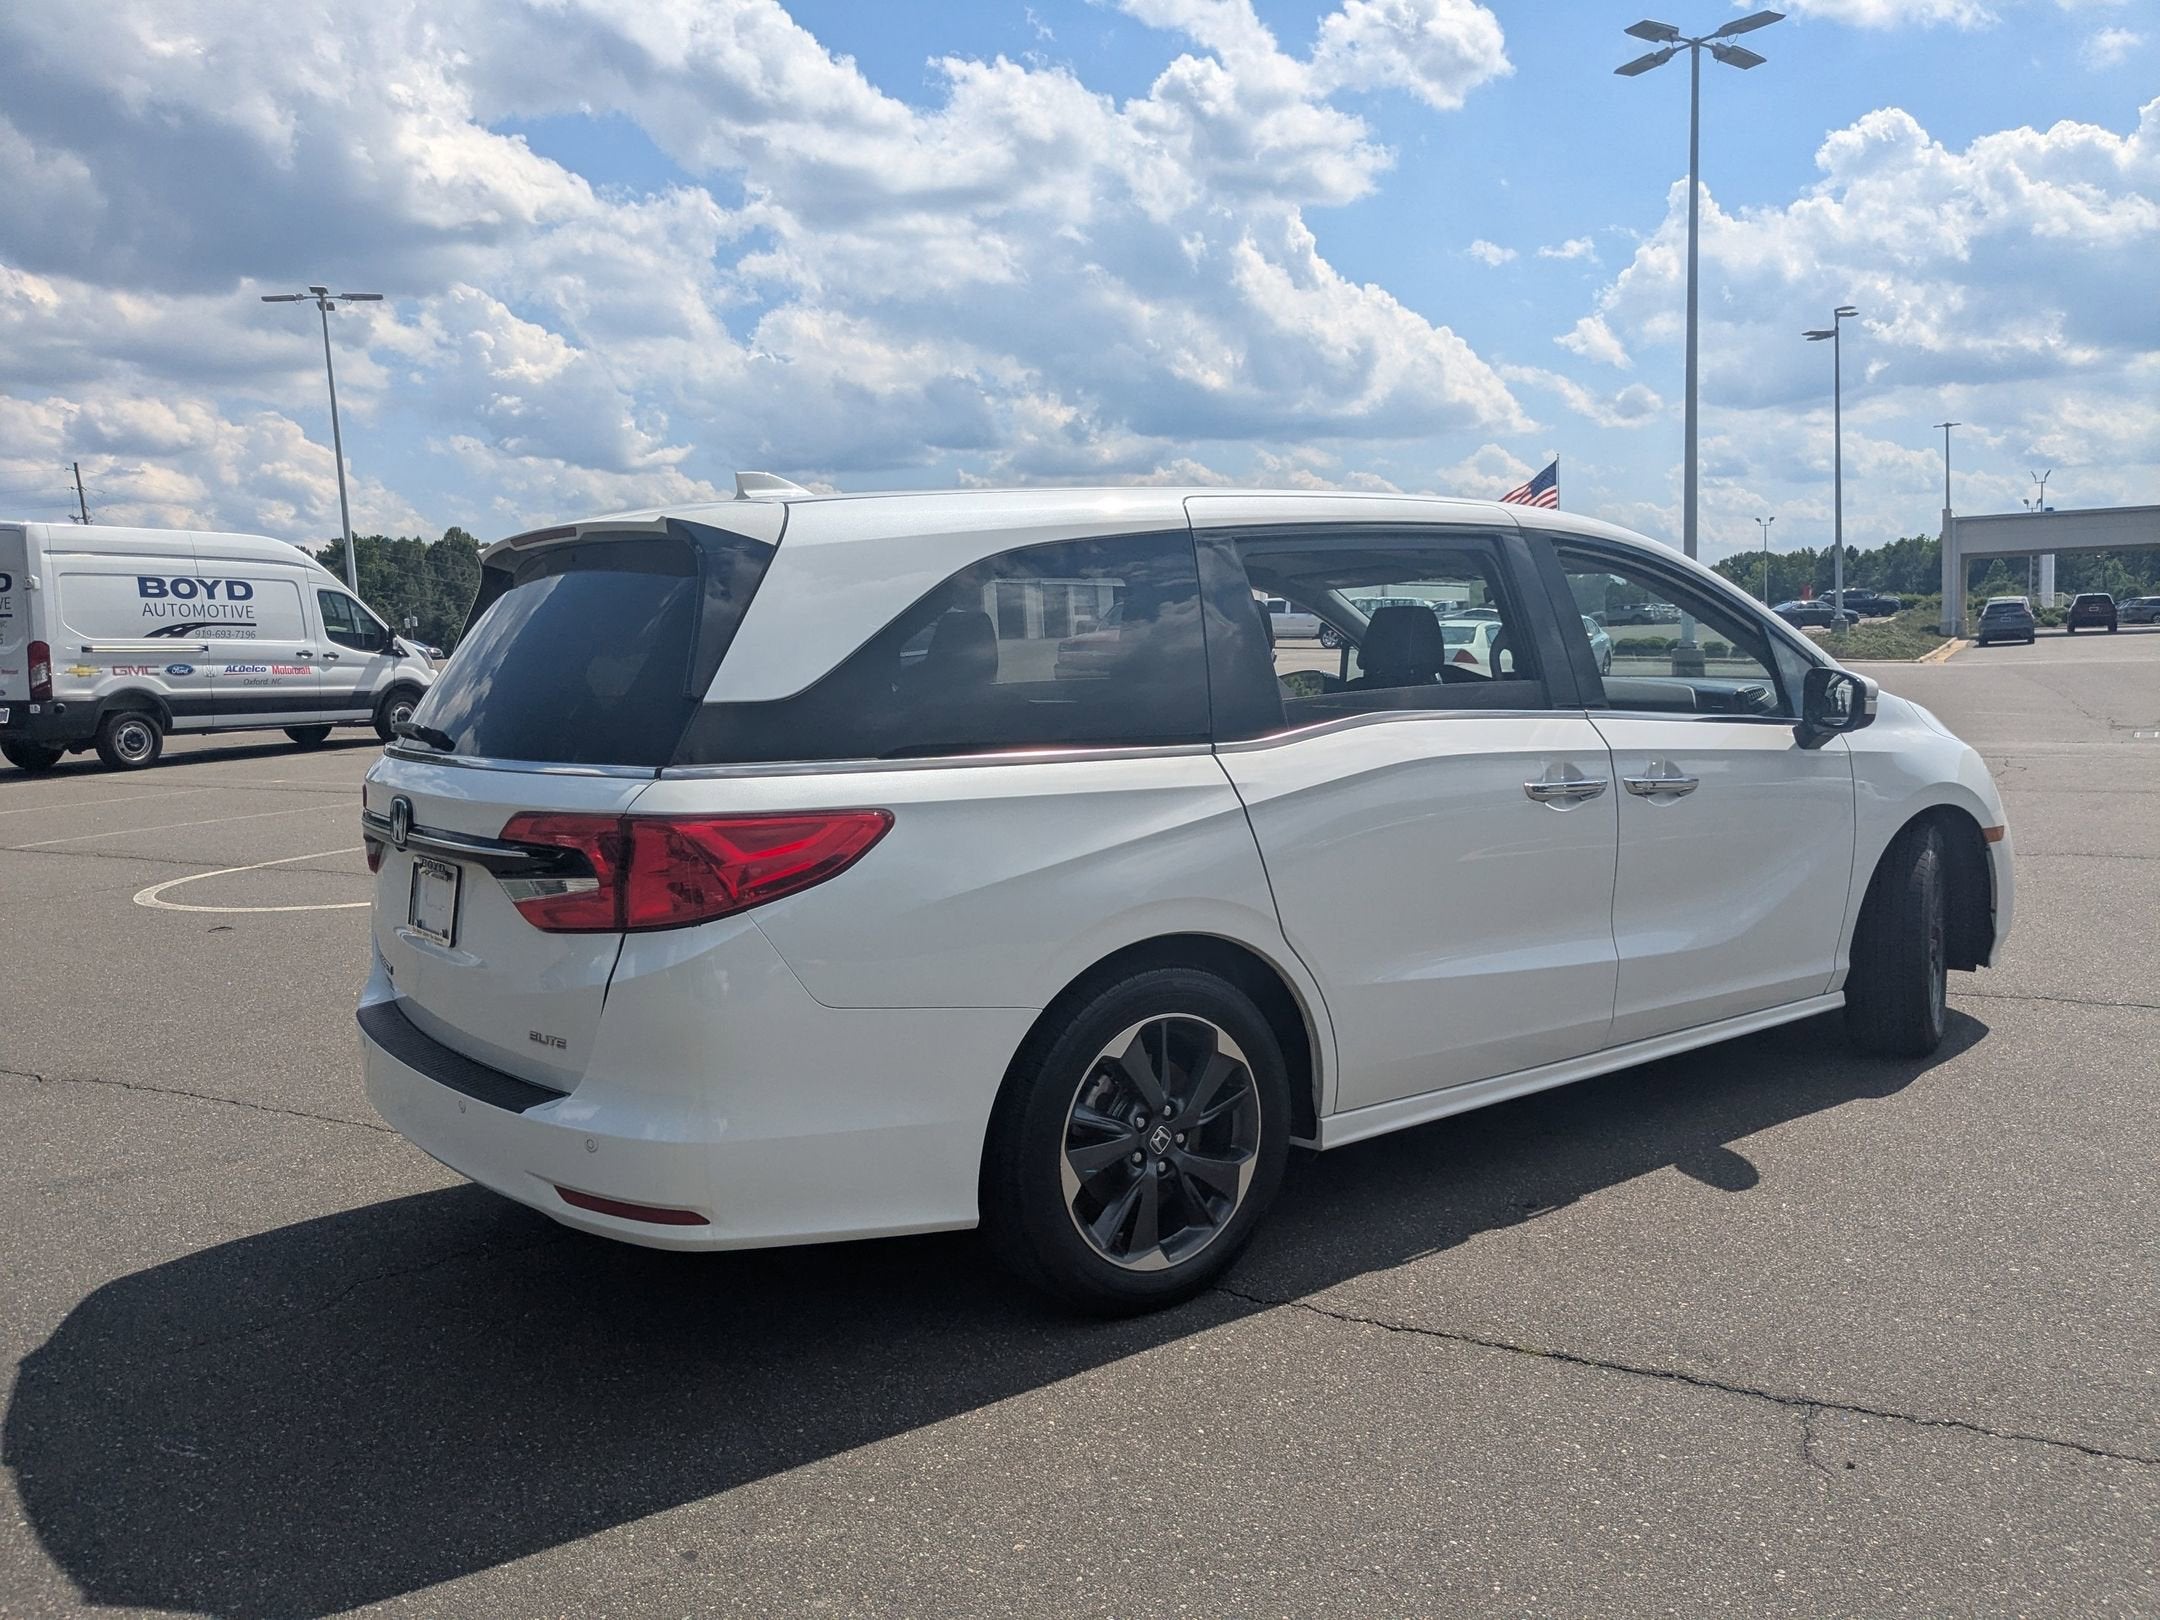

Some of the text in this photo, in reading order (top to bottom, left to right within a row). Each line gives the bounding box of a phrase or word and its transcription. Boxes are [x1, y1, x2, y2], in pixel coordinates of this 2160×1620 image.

[137, 577, 254, 601] BOYD
[142, 602, 255, 619] AUTOMOTIVE
[195, 630, 256, 639] 919-693-7196
[112, 666, 160, 676] GMC
[171, 666, 189, 674] Ford
[224, 665, 267, 673] ACDelco
[271, 666, 312, 675] Motorcraft
[529, 1030, 567, 1050] ELITE
